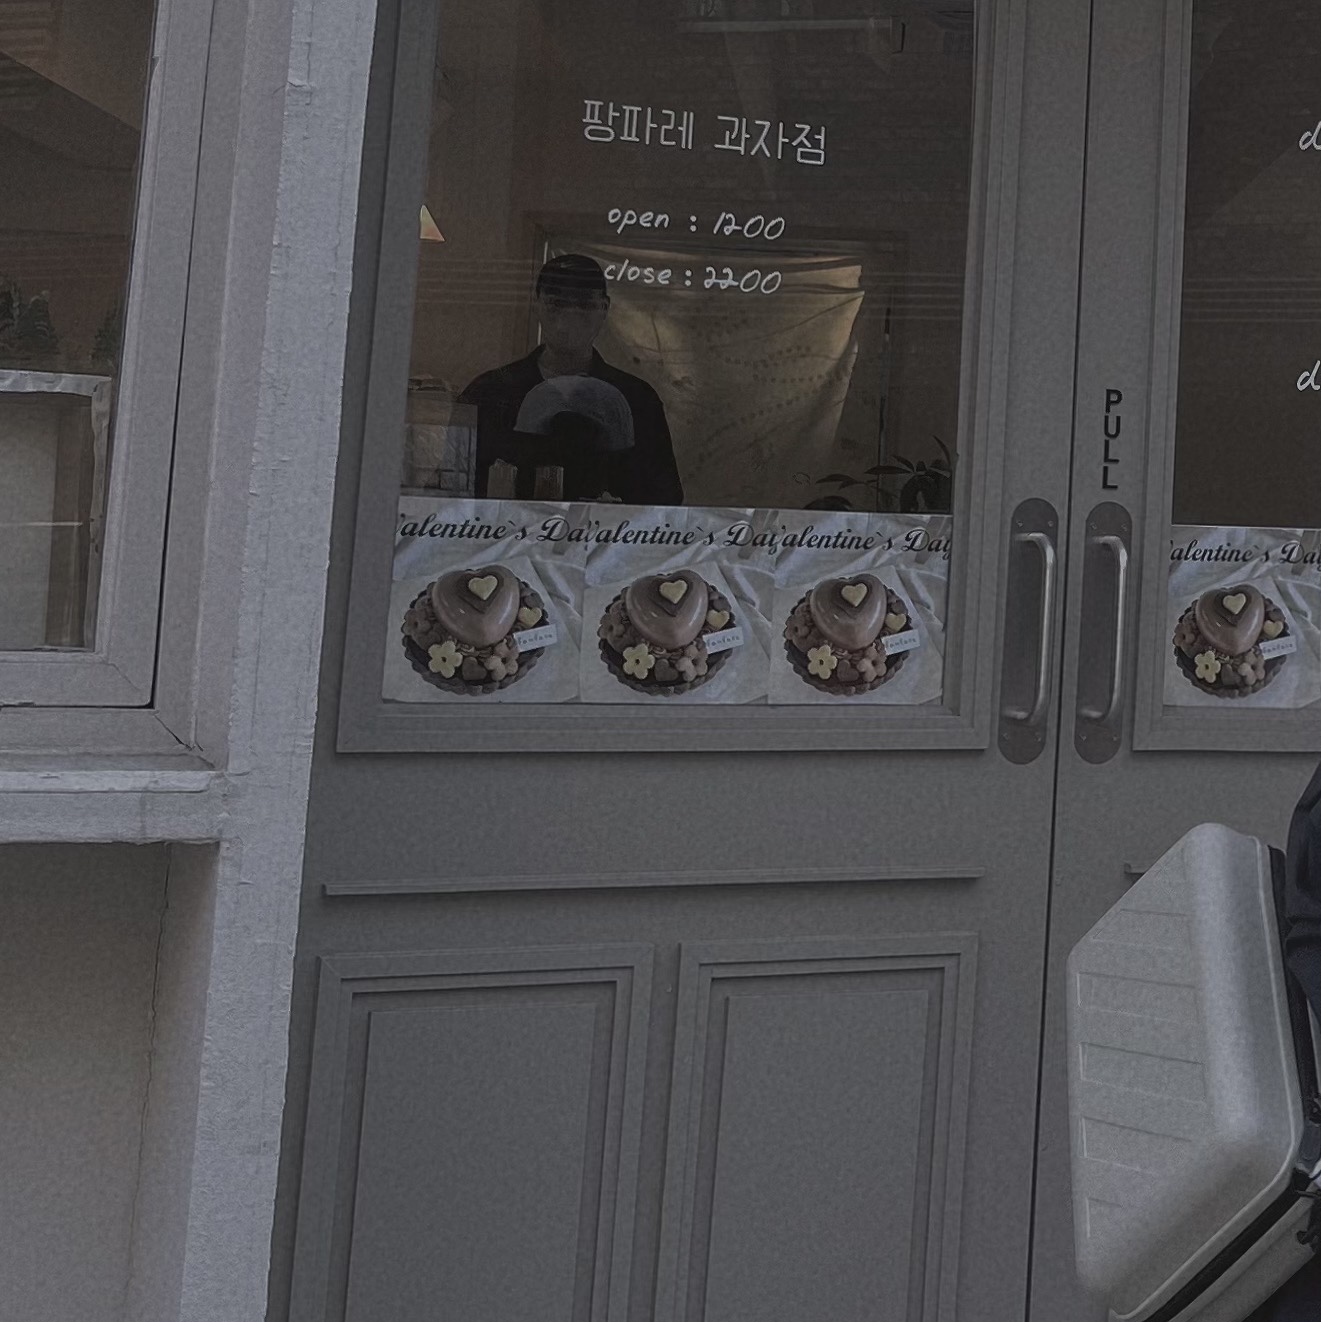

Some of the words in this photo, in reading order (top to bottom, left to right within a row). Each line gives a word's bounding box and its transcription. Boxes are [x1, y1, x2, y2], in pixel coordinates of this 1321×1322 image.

[582, 99, 694, 149] 팡파레
[713, 114, 827, 165] 과자점
[607, 208, 670, 234] open
[712, 211, 786, 240] 1200
[603, 258, 672, 285] close
[703, 266, 783, 294] 2200
[1102, 388, 1123, 490] PULL
